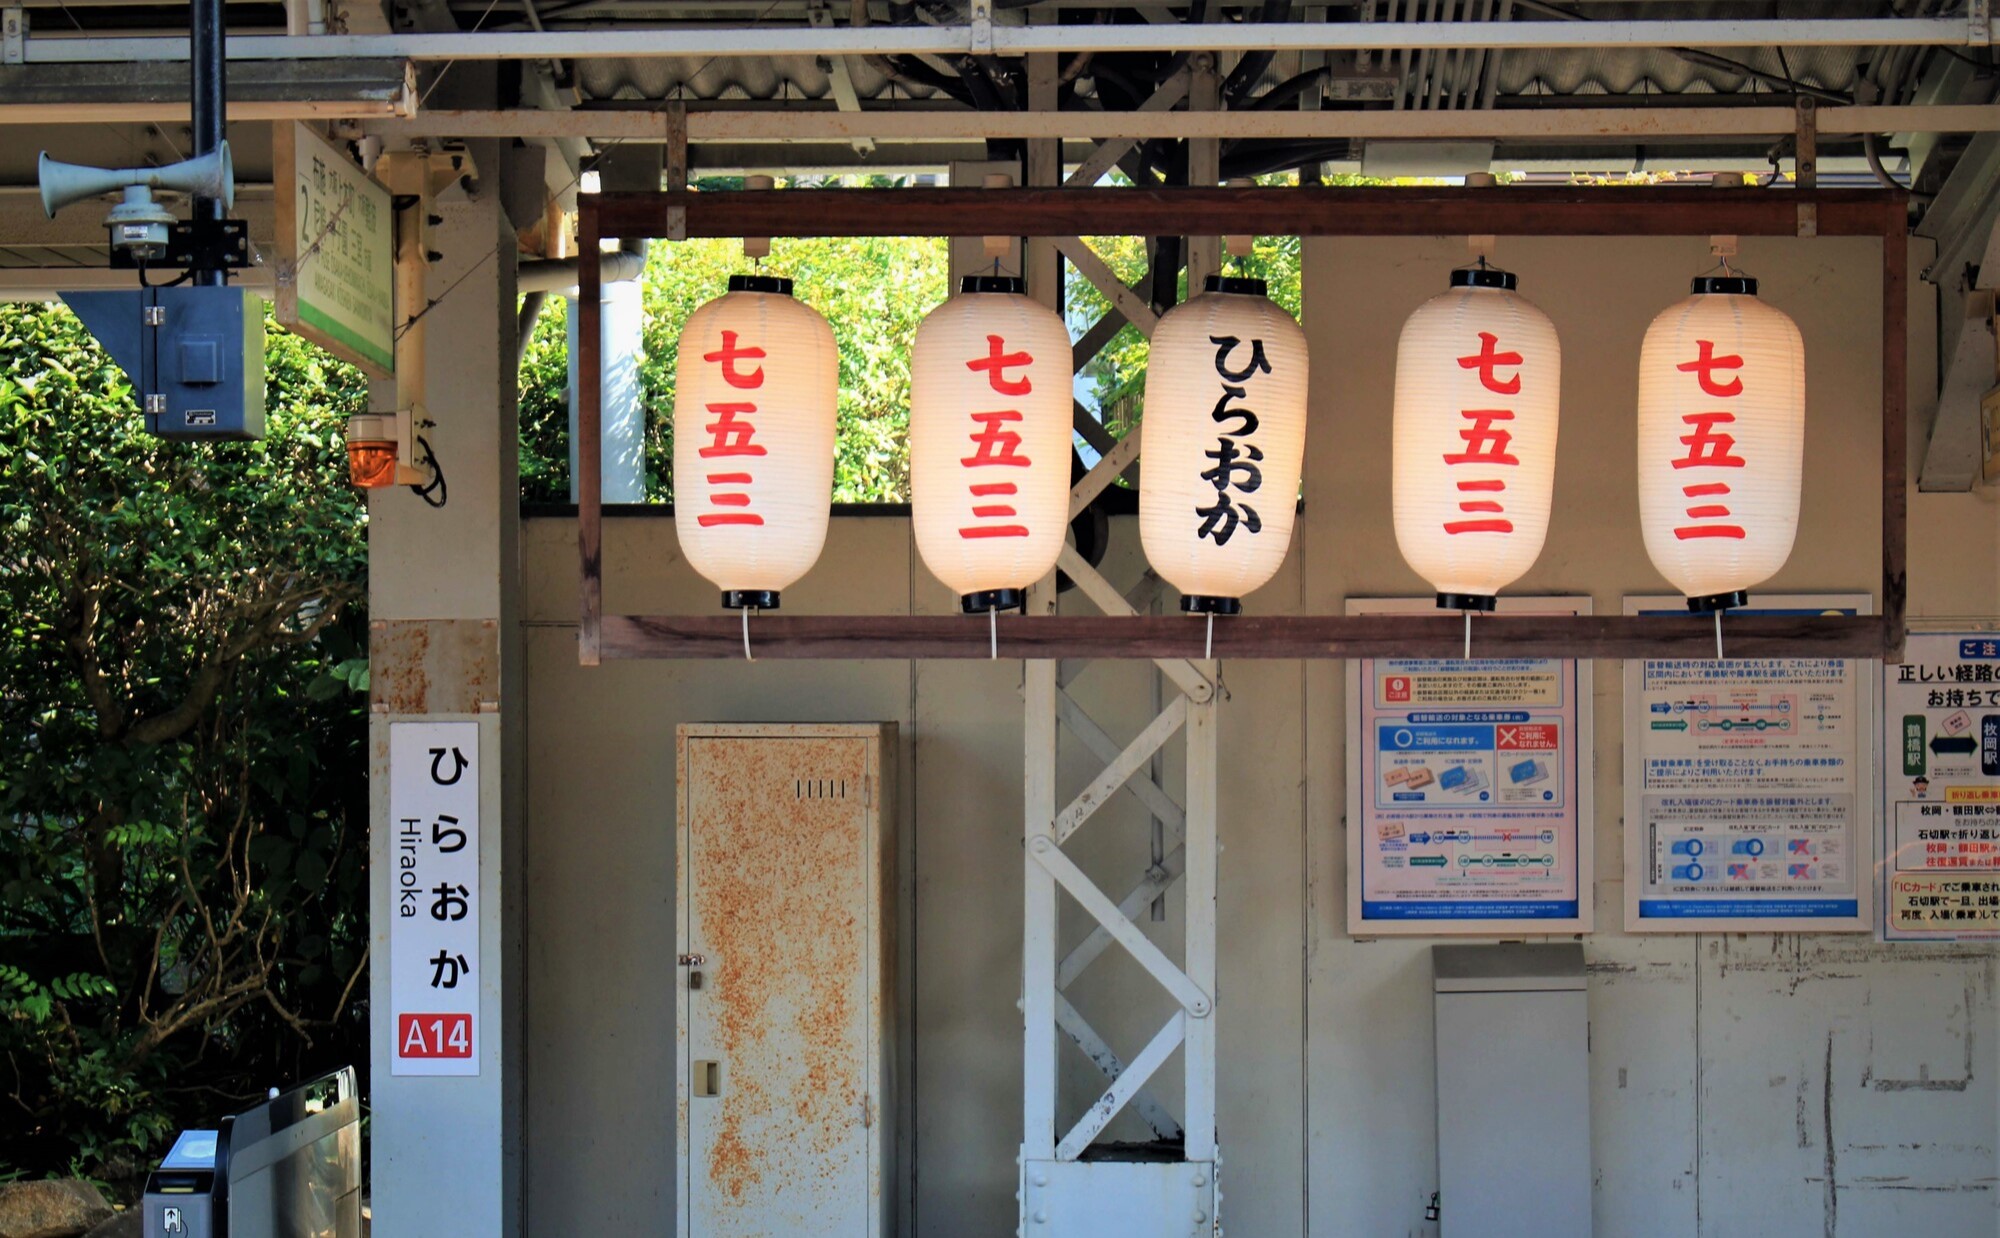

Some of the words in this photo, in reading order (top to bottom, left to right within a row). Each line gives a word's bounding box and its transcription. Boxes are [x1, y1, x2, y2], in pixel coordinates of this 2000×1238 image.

[301, 184, 309, 243] 2
[697, 330, 767, 527] 七五三
[958, 335, 1033, 539] 七五三
[1195, 334, 1272, 547] ひらおか
[1443, 331, 1523, 534] 七五三
[1672, 340, 1746, 540] 七五三
[1907, 723, 1921, 766] 鶴橋駅
[1984, 723, 1997, 765] 枚岡駅
[1952, 791, 2000, 799] 折り返し乗車
[400, 818, 423, 918] Hiraoka
[429, 747, 469, 989] ひらおか
[1926, 843, 2000, 853] 枚岡・額田駅か
[404, 1019, 469, 1054] A14
